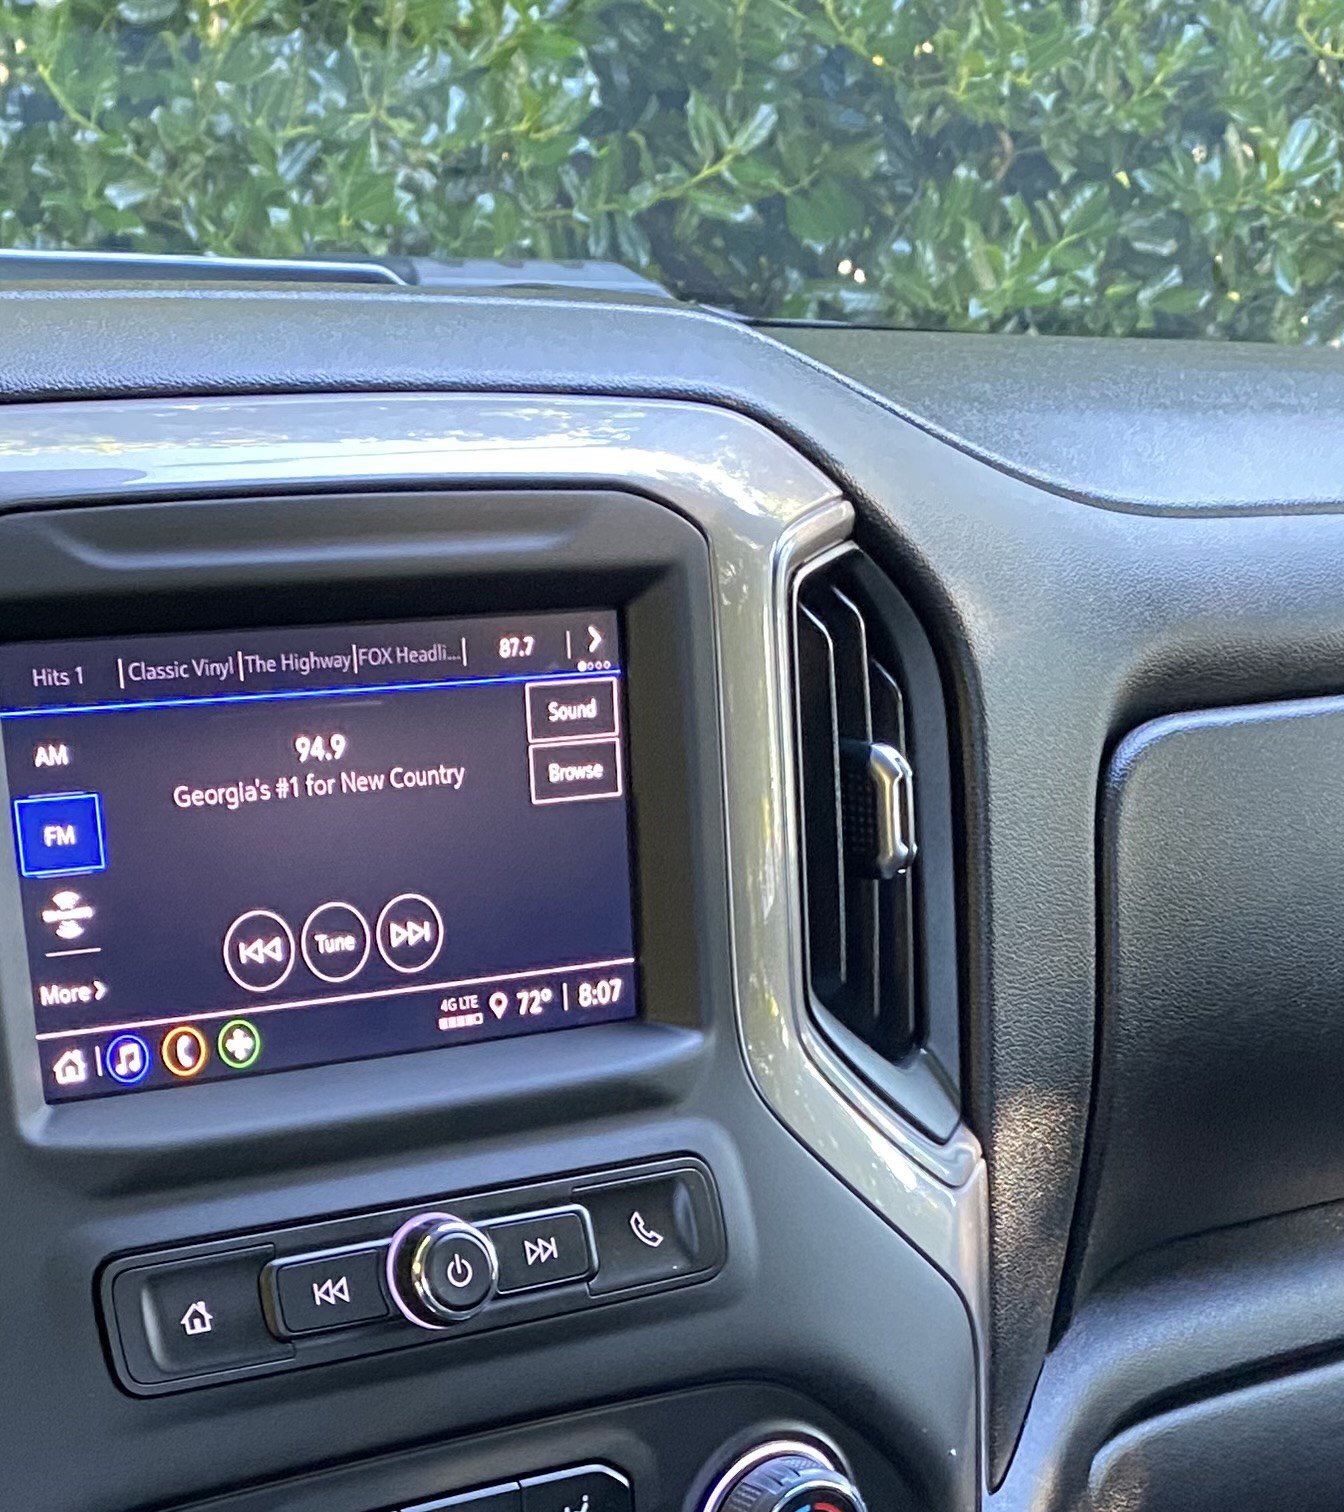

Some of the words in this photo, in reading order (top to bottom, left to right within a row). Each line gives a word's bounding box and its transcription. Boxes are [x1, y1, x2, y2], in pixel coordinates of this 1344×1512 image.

[359, 647, 394, 666] FOX
[498, 635, 534, 659] 87.7
[128, 660, 189, 681] Classic
[192, 656, 234, 680] Vinyl
[244, 655, 277, 675] The
[281, 651, 352, 676] Highway
[32, 668, 71, 686] Hits
[74, 666, 83, 684] 1
[547, 698, 597, 722] Sound
[34, 744, 70, 768] AM
[295, 733, 346, 763] 94.9
[548, 762, 604, 784] Browse
[173, 779, 271, 810] Georgia's
[275, 776, 299, 799] #1
[306, 773, 336, 796] for
[339, 771, 384, 793] New
[389, 765, 465, 789] Country
[43, 824, 76, 847] FM
[314, 932, 356, 954] Tune
[40, 985, 90, 1006] More
[440, 996, 458, 1012] 4G
[458, 994, 480, 1011] LTE
[578, 978, 623, 1008] 8:07
